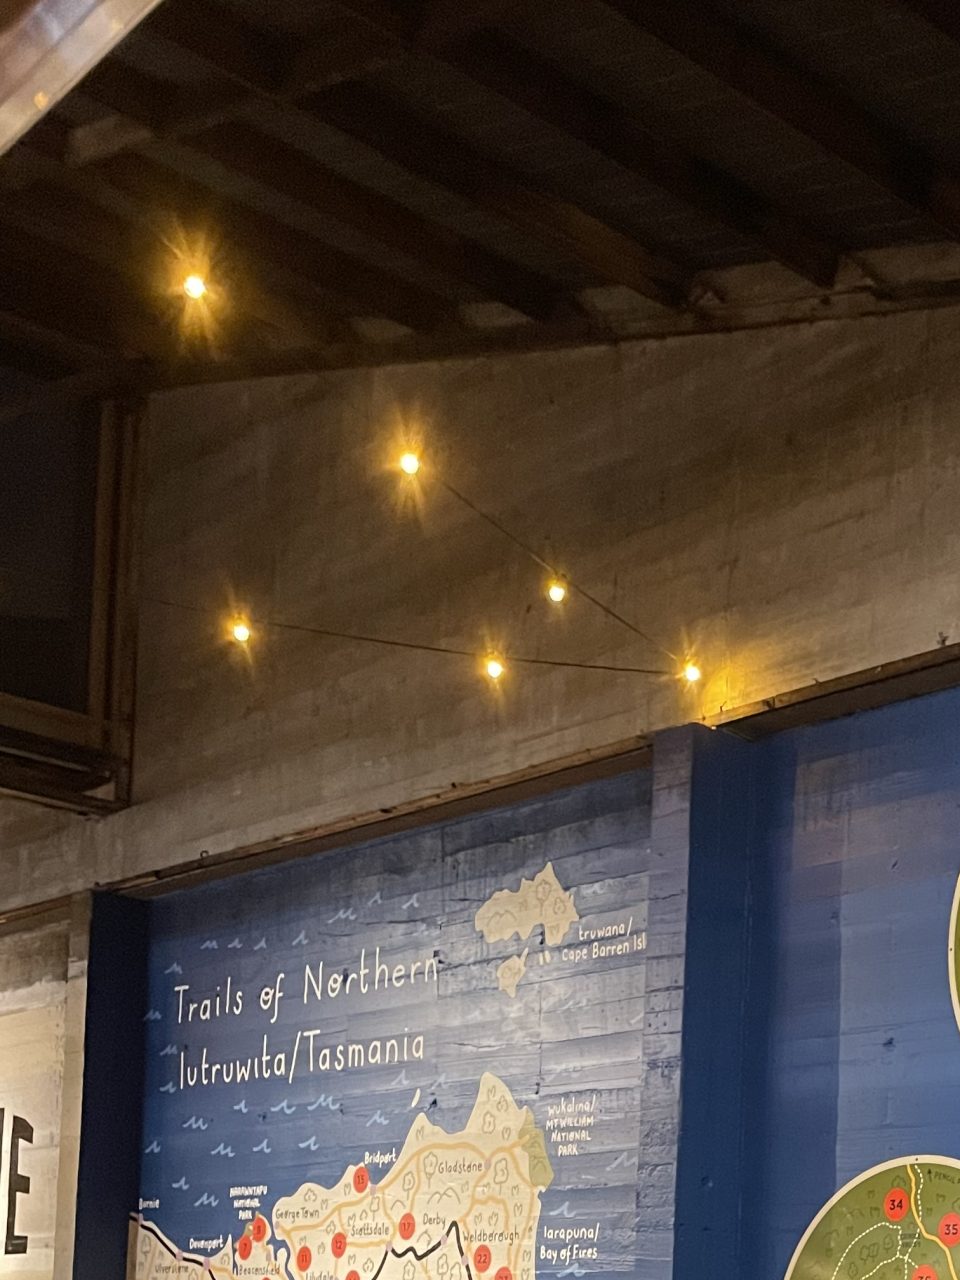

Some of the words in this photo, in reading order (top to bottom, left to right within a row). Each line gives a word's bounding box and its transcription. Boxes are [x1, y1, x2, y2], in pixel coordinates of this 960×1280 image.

[579, 917, 632, 941] truwana/
[562, 946, 587, 964] Cape
[592, 941, 630, 959] Barren
[174, 976, 243, 1023] Trails
[557, 1144, 578, 1156] PARK
[0, 1108, 33, 1254] E
[889, 1199, 903, 1211] 34
[423, 1213, 446, 1229] Derby
[944, 1224, 958, 1236] 35
[543, 1223, 600, 1243] larapuna/
[477, 1254, 488, 1263] 22
[540, 1245, 557, 1264] Bay
[573, 1244, 598, 1259] Fires
